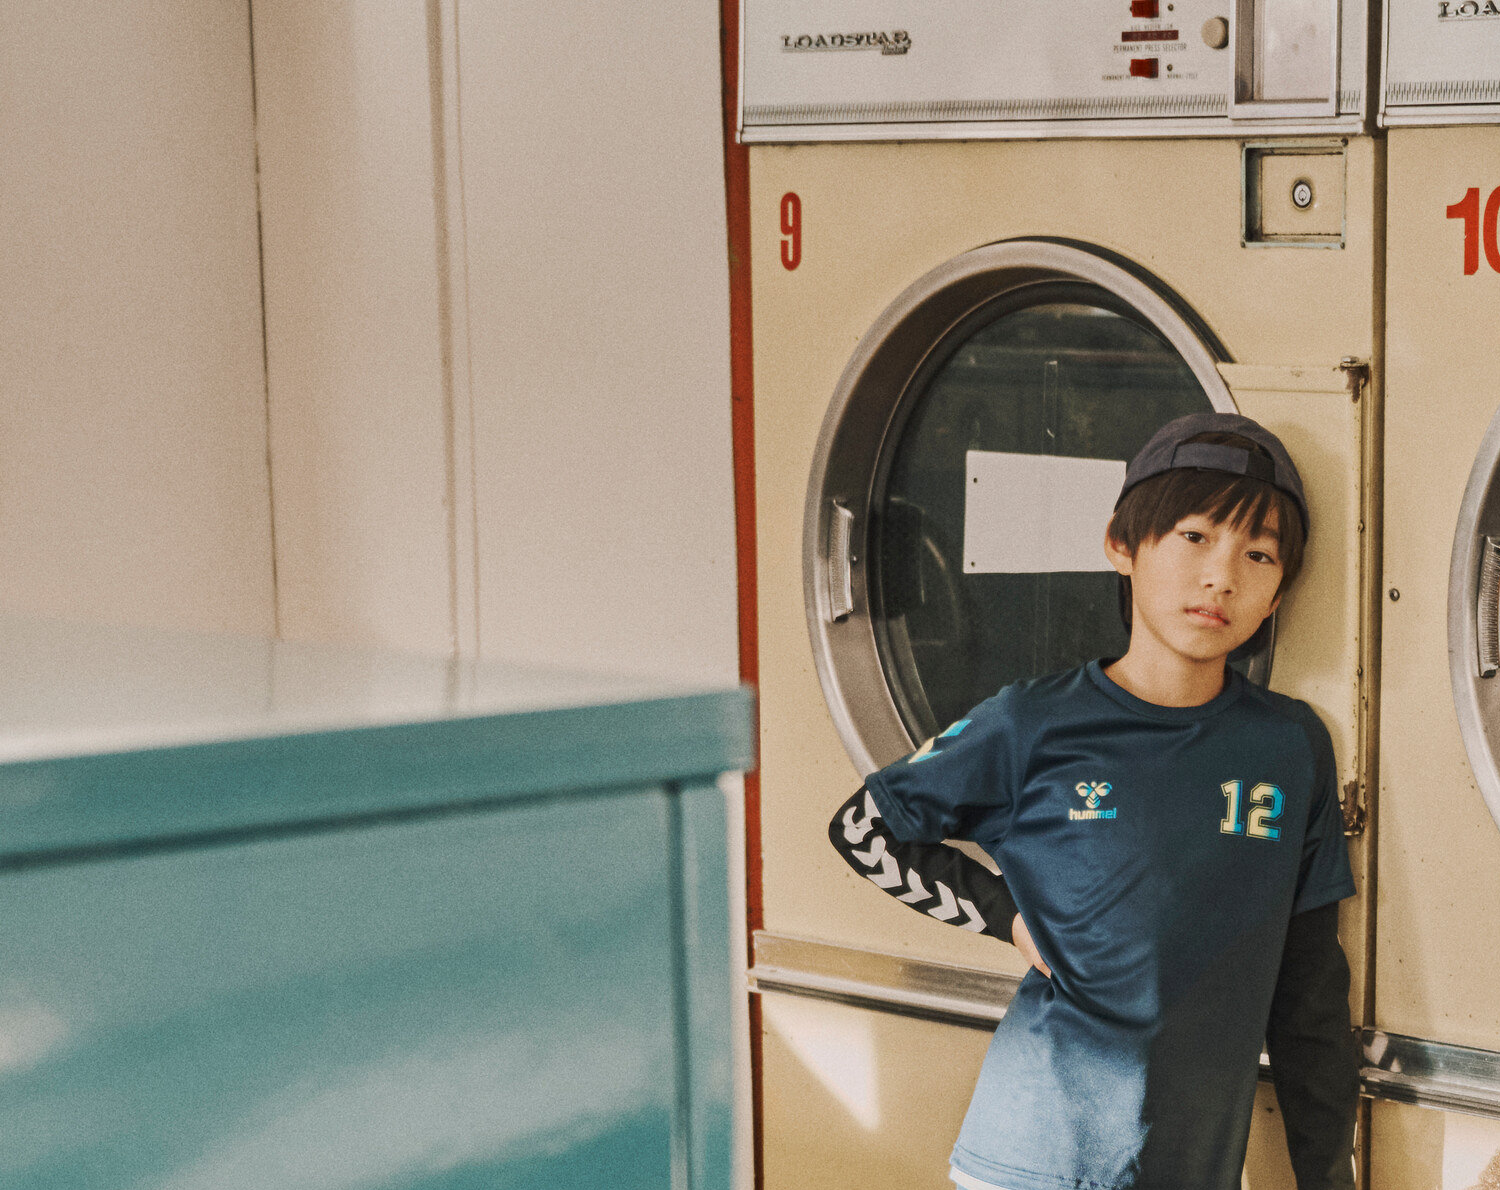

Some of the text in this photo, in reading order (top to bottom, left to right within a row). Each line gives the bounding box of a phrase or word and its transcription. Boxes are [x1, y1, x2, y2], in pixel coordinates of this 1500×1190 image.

[779, 191, 803, 272] 9
[1068, 807, 1118, 821] hummel
[1219, 779, 1286, 842] 12
